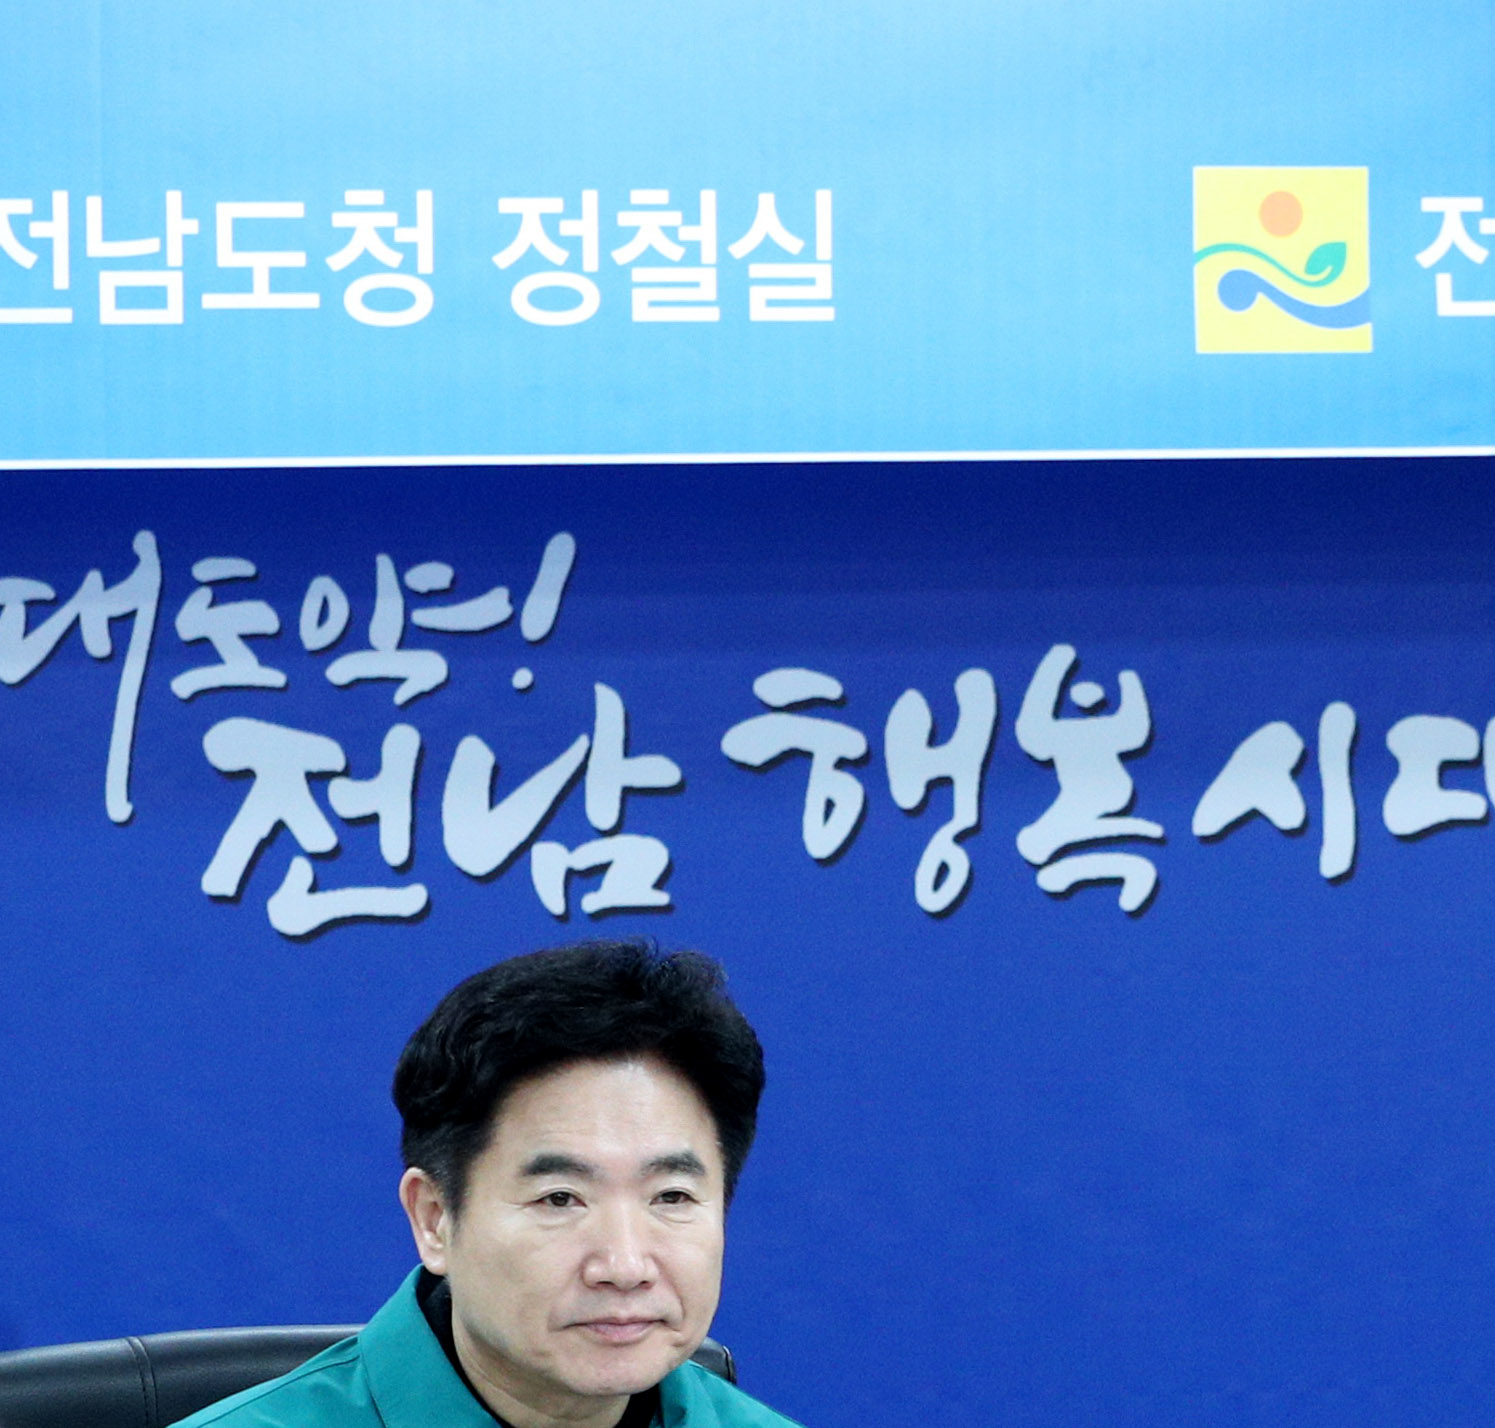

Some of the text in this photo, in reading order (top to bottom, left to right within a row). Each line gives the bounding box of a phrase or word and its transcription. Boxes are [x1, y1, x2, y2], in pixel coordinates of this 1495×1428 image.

[0, 189, 836, 327] 전남도청 정철실
[202, 683, 682, 935] 전남
